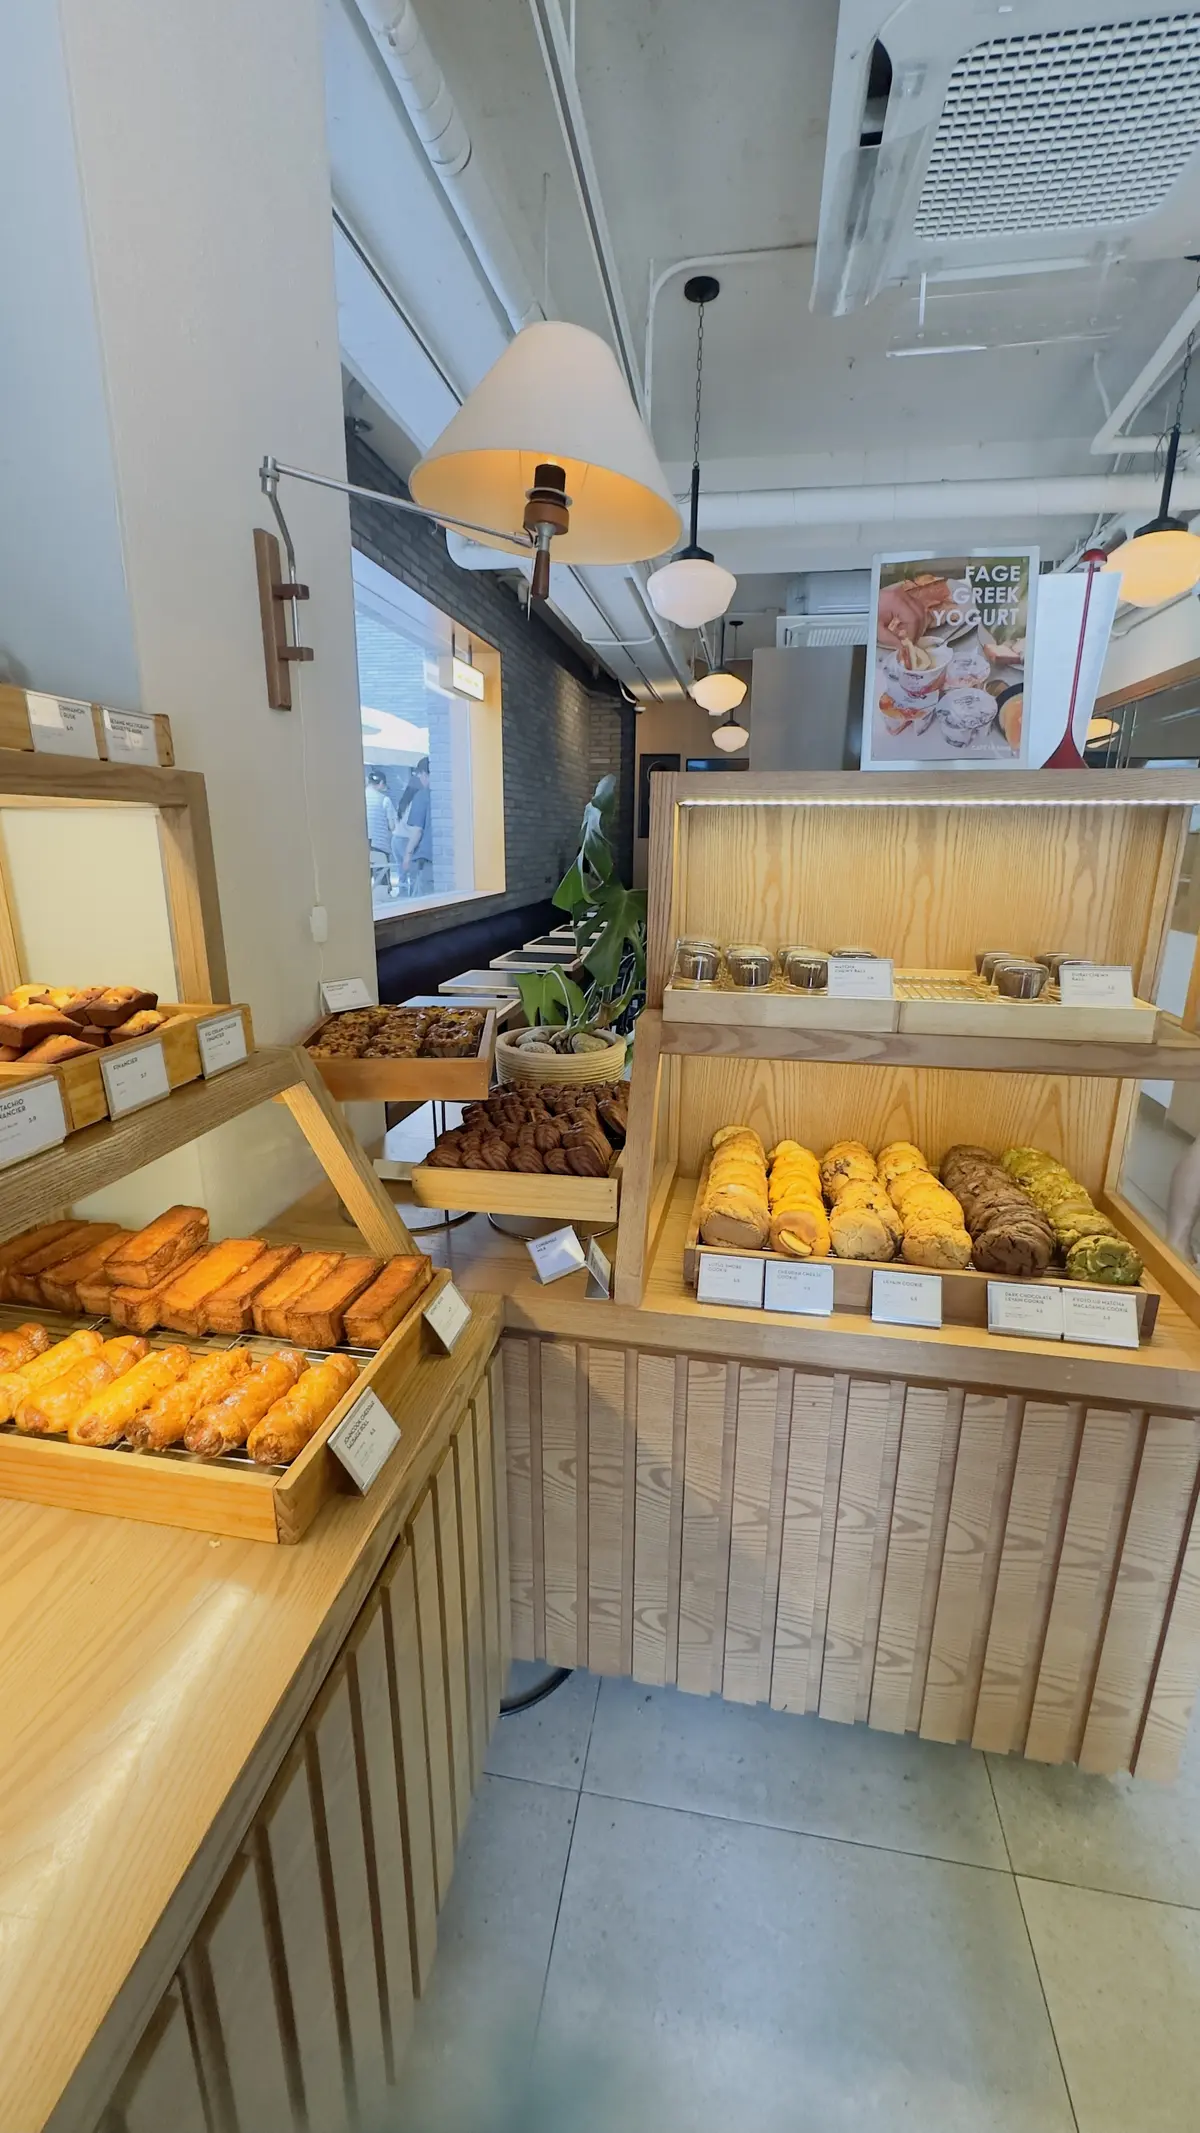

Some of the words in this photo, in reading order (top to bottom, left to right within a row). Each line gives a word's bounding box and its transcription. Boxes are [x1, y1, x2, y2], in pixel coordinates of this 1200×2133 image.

[965, 565, 1021, 582] FAGE
[952, 586, 1019, 604] GREEK
[932, 607, 1019, 627] YOGURT
[113, 1056, 138, 1070] FINANCIER
[0, 1105, 26, 1119] ANCIER
